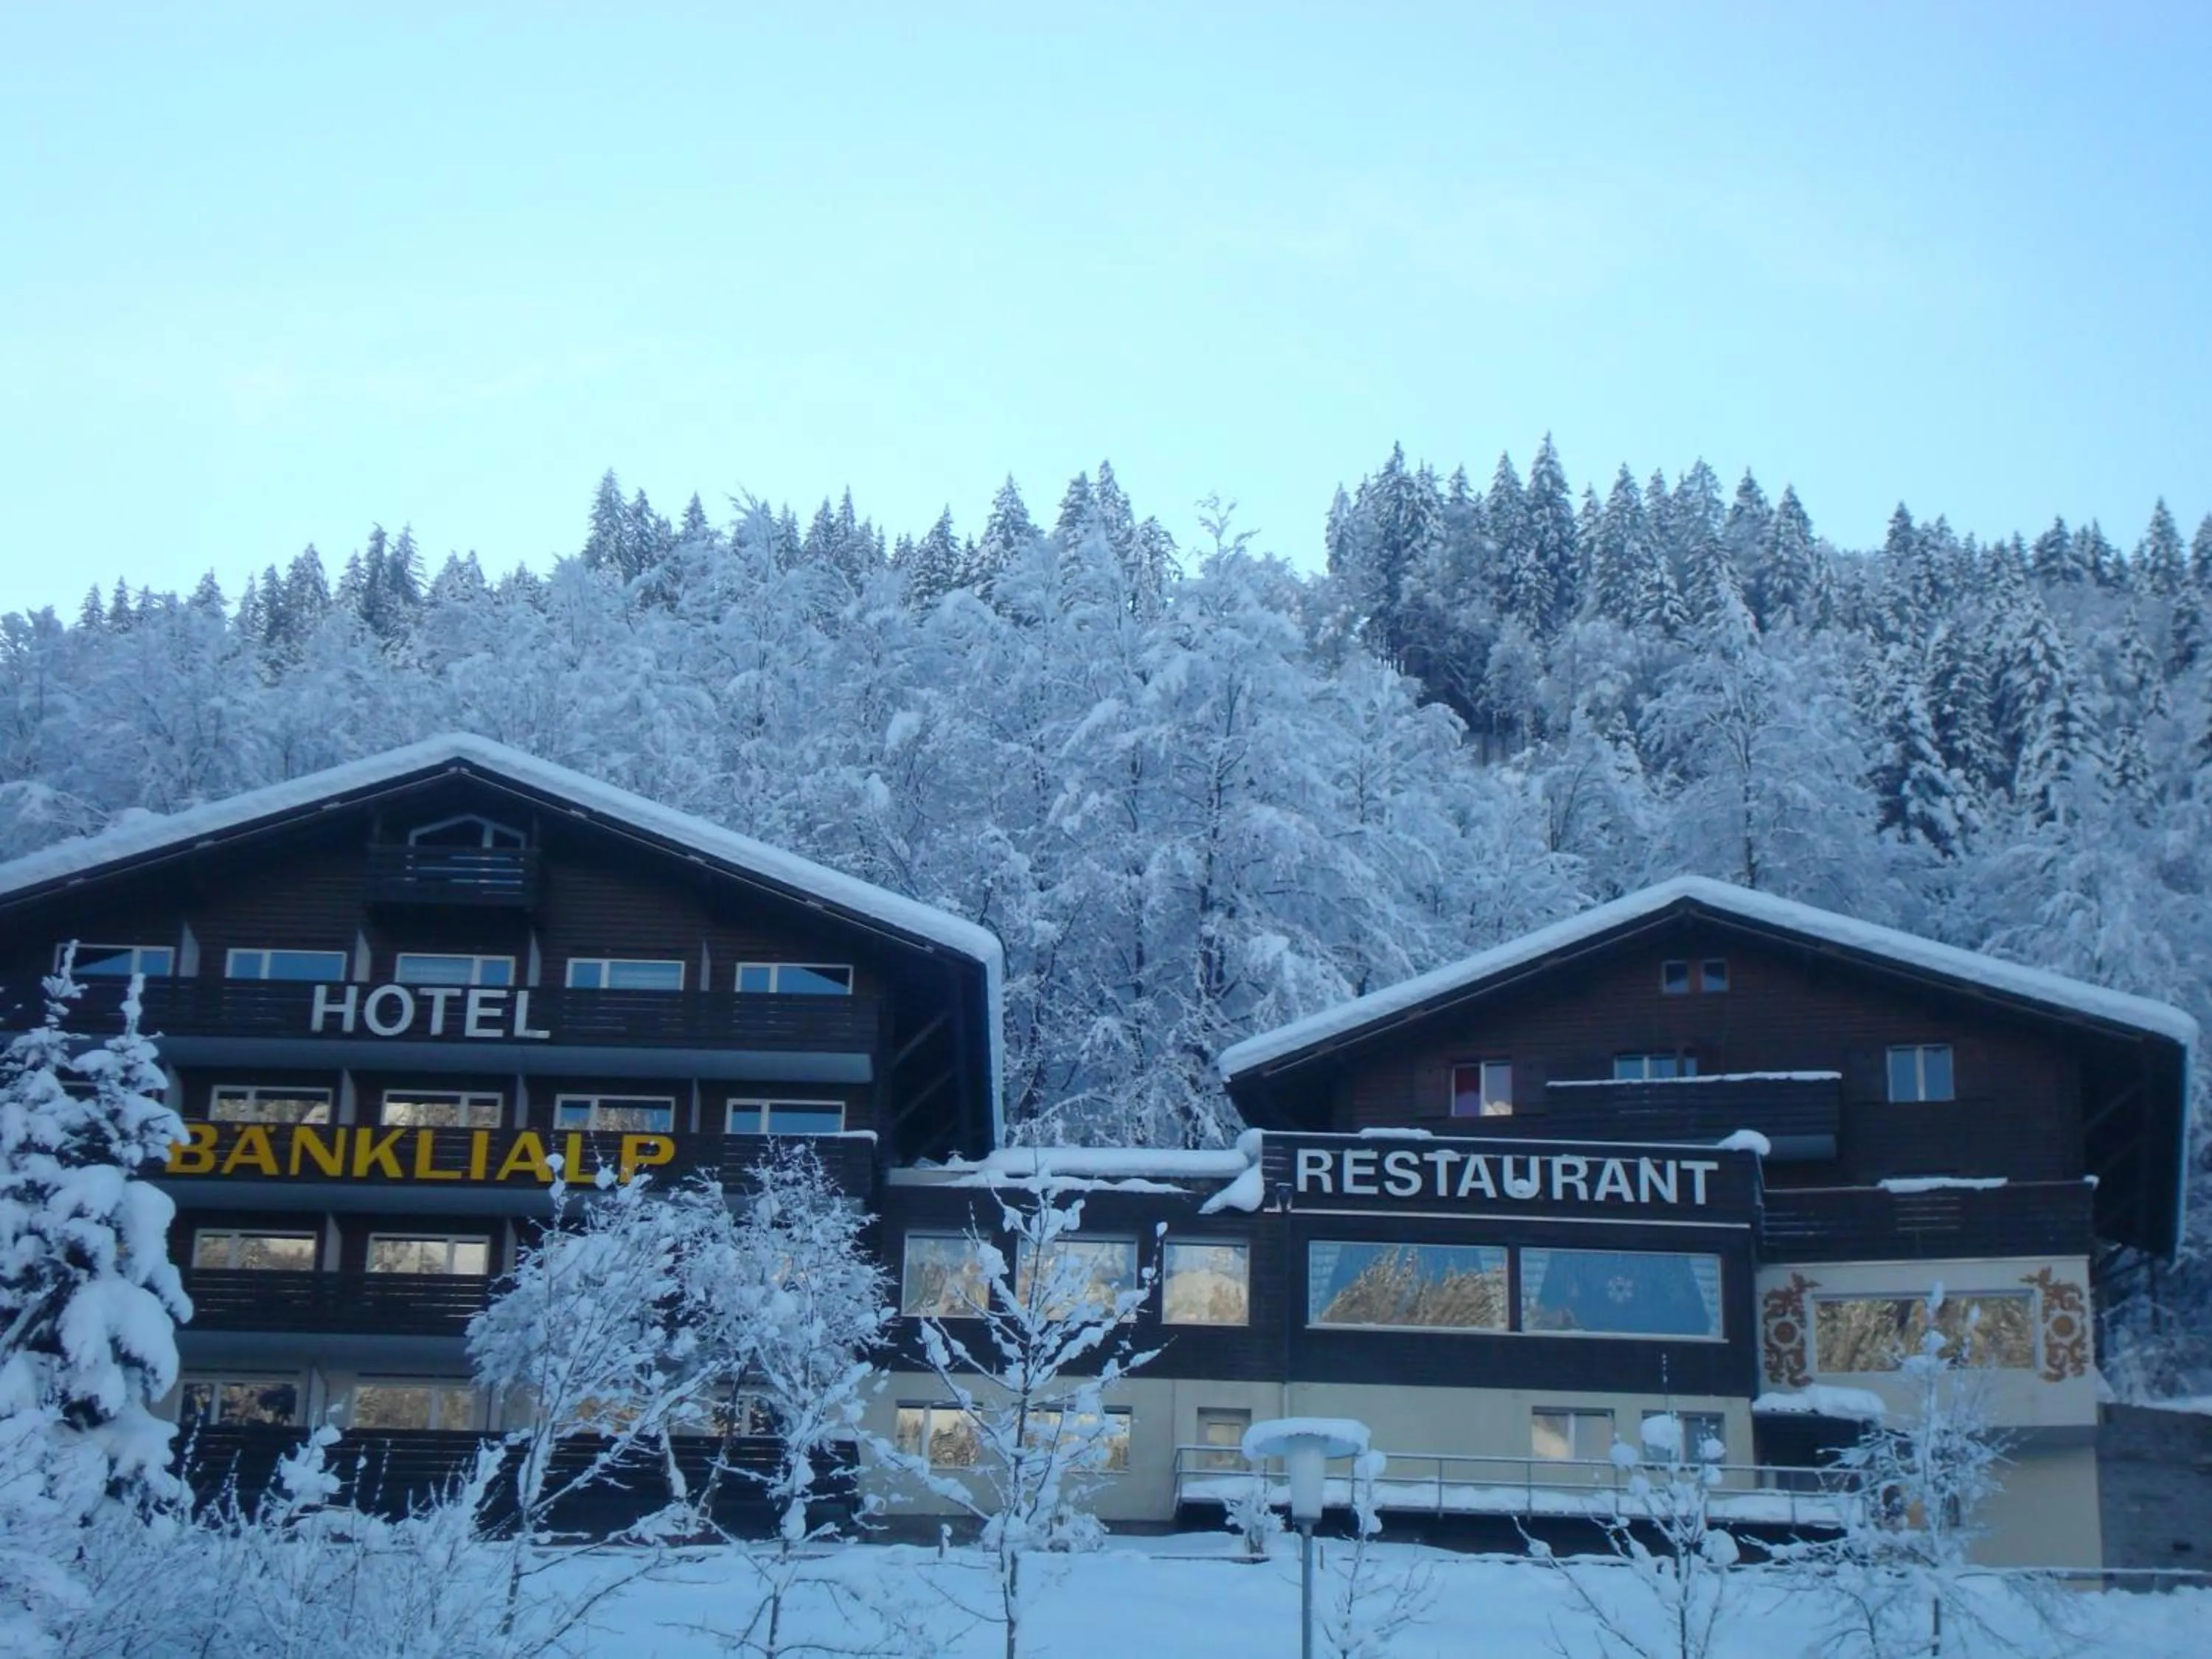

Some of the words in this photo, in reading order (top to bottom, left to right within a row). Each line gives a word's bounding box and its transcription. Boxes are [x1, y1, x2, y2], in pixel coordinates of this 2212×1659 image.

[311, 984, 551, 1039] HOTEL
[164, 1124, 675, 1184] BÄNKLIALP
[1295, 1147, 1719, 1206] RESTAURANT
